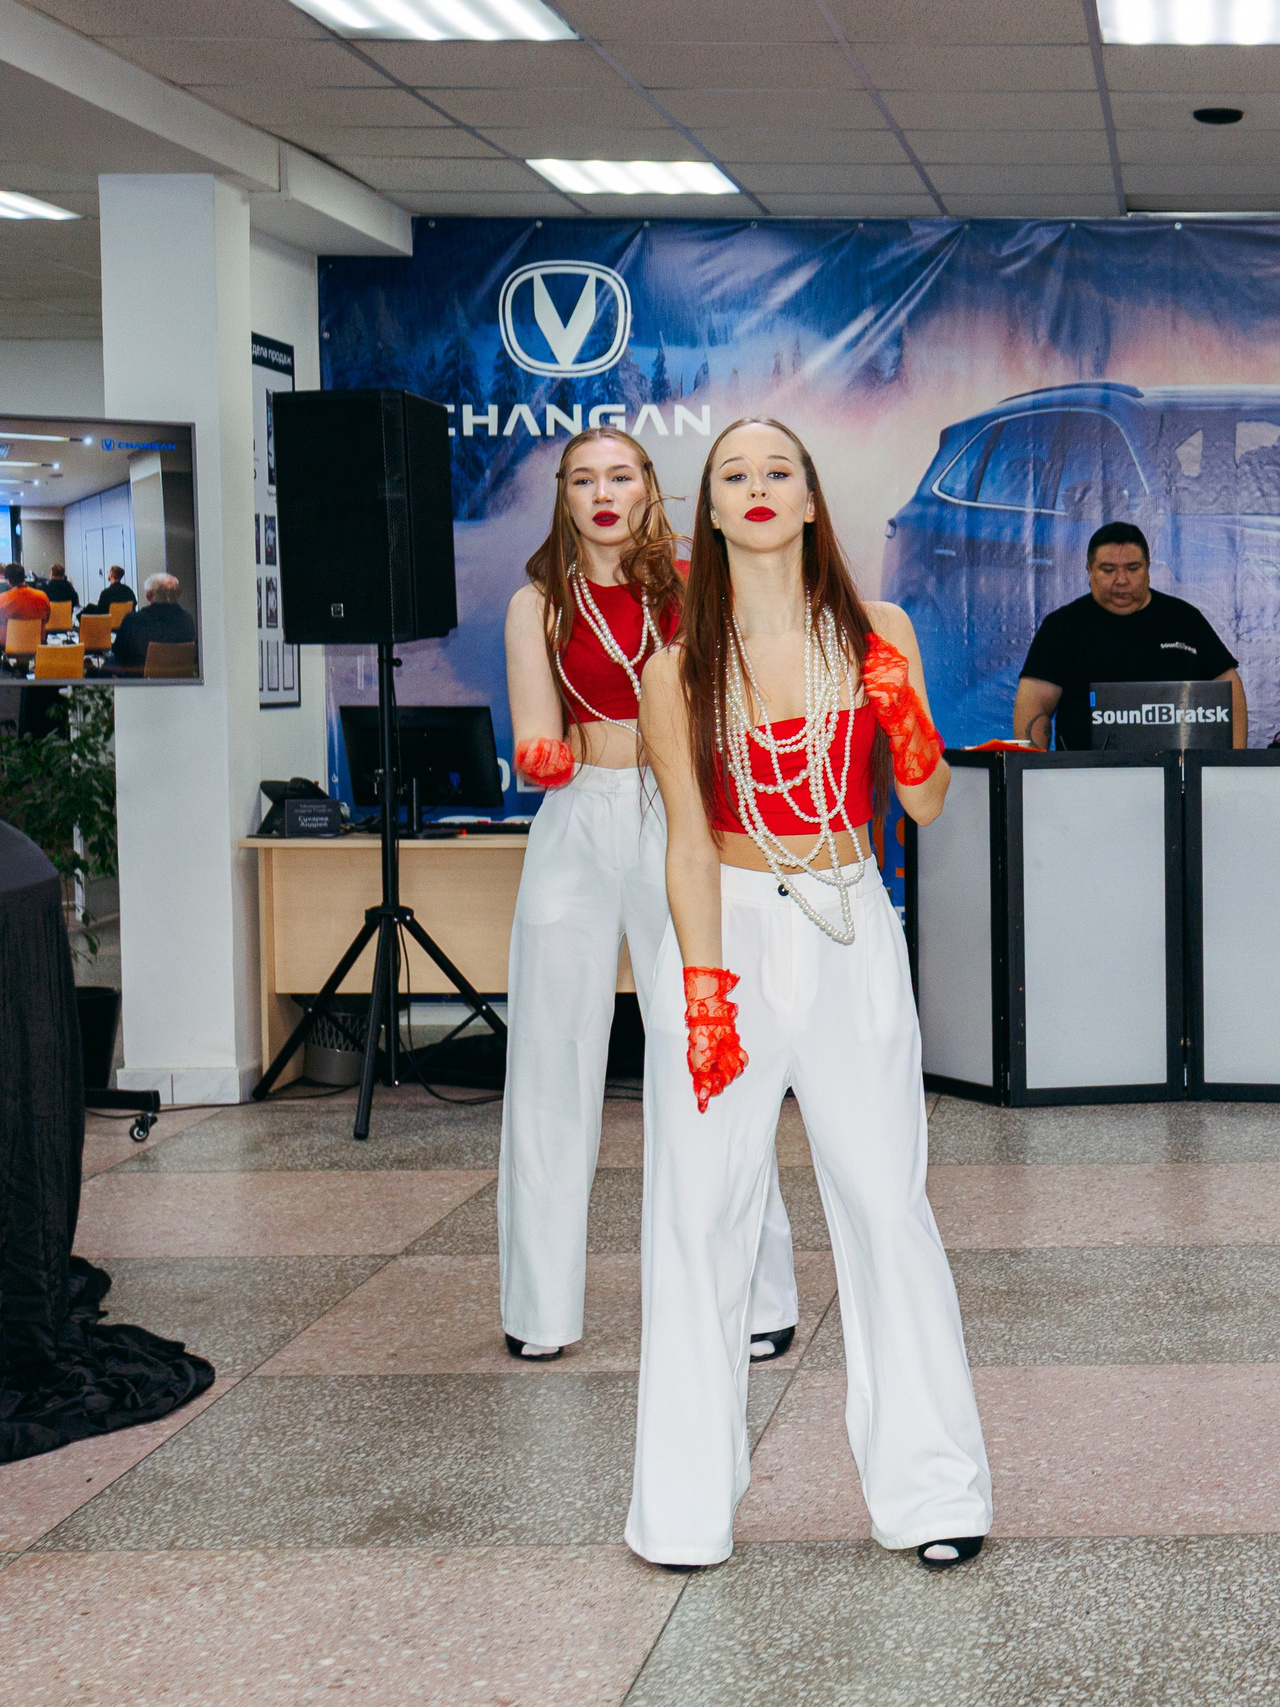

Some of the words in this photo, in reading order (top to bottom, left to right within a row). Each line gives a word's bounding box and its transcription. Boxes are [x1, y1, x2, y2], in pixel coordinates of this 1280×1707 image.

[252, 344, 267, 359] дела
[268, 349, 293, 367] продаж
[1092, 704, 1229, 725] soundBratsk
